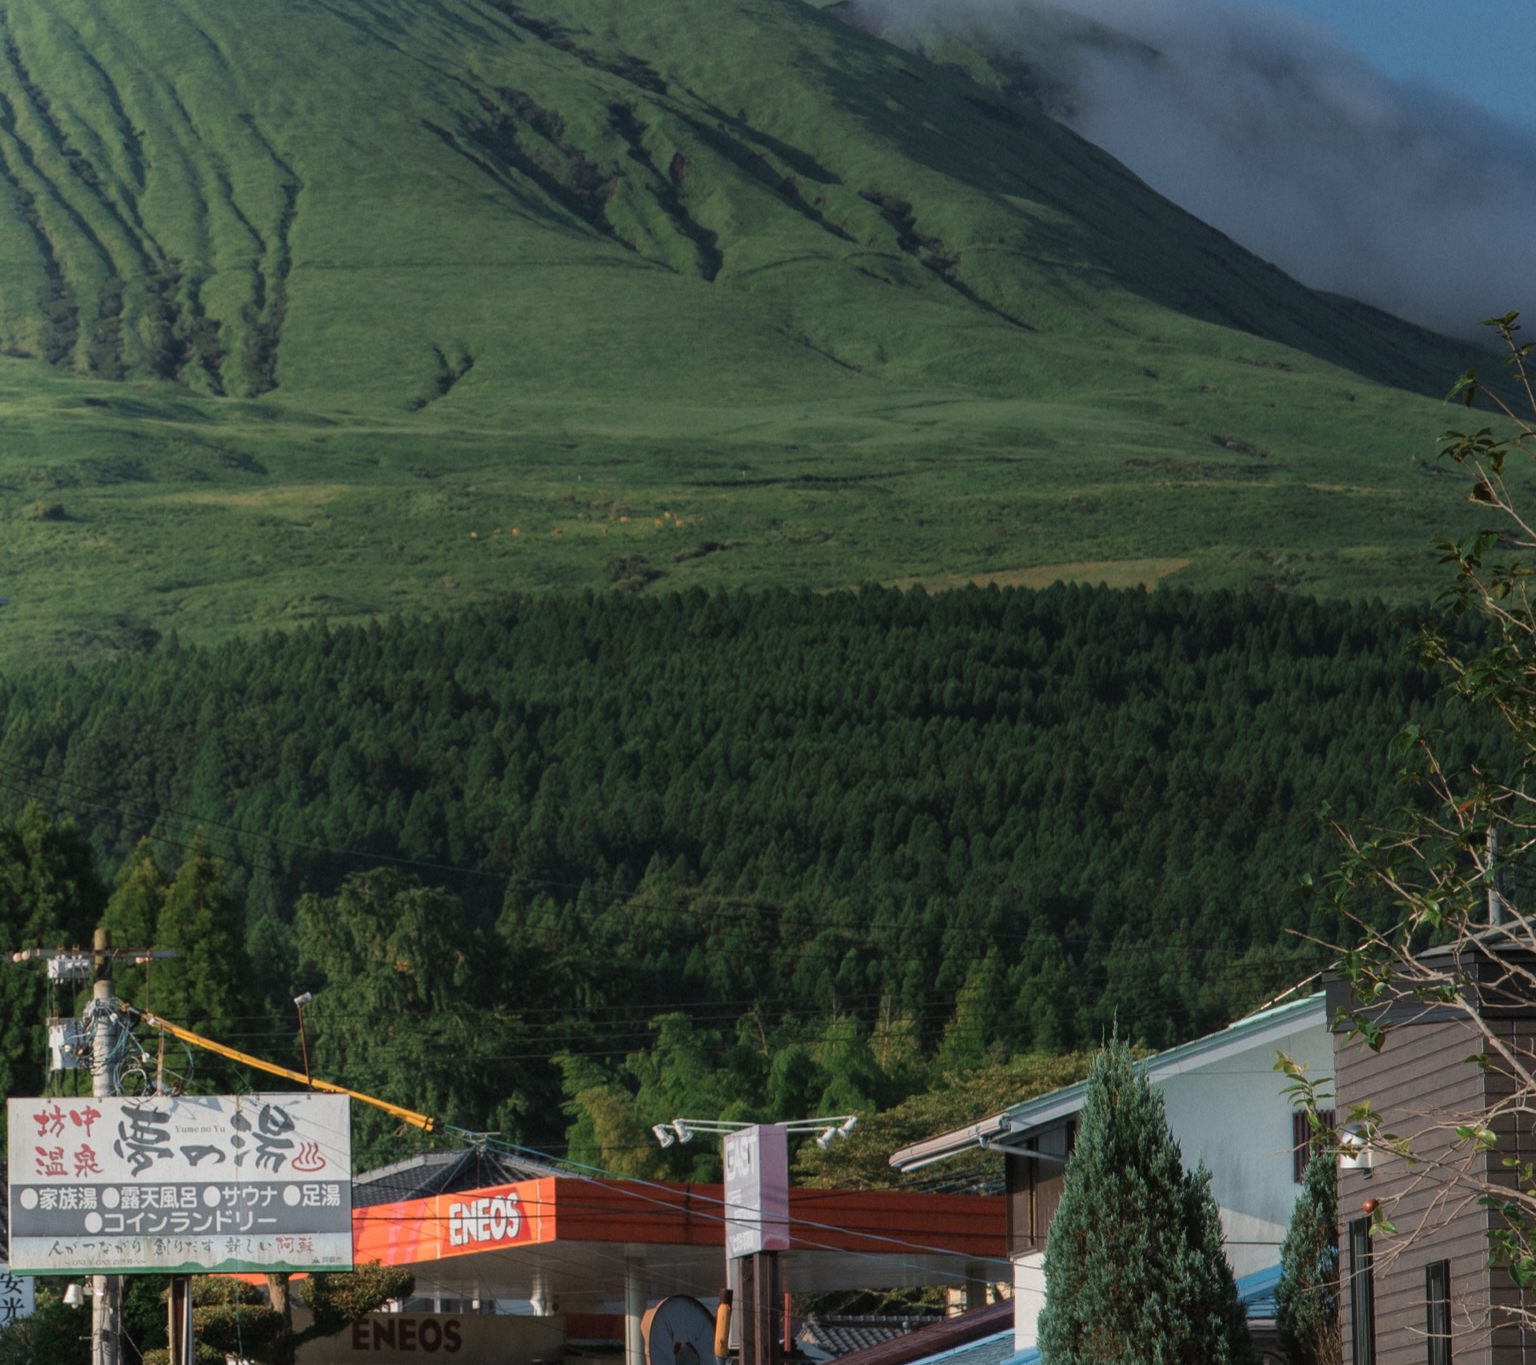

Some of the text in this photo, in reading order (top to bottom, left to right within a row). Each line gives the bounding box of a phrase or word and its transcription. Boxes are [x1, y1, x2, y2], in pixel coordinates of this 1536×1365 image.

[33, 1104, 102, 1138] 坊中
[175, 1124, 226, 1134] Yume no Yu
[113, 1103, 295, 1178] 夢の湯
[35, 1143, 104, 1178] 温泉
[104, 1210, 277, 1233] コインランドリー
[449, 1192, 520, 1246] ENEOS
[351, 1317, 462, 1354] ENEOS
